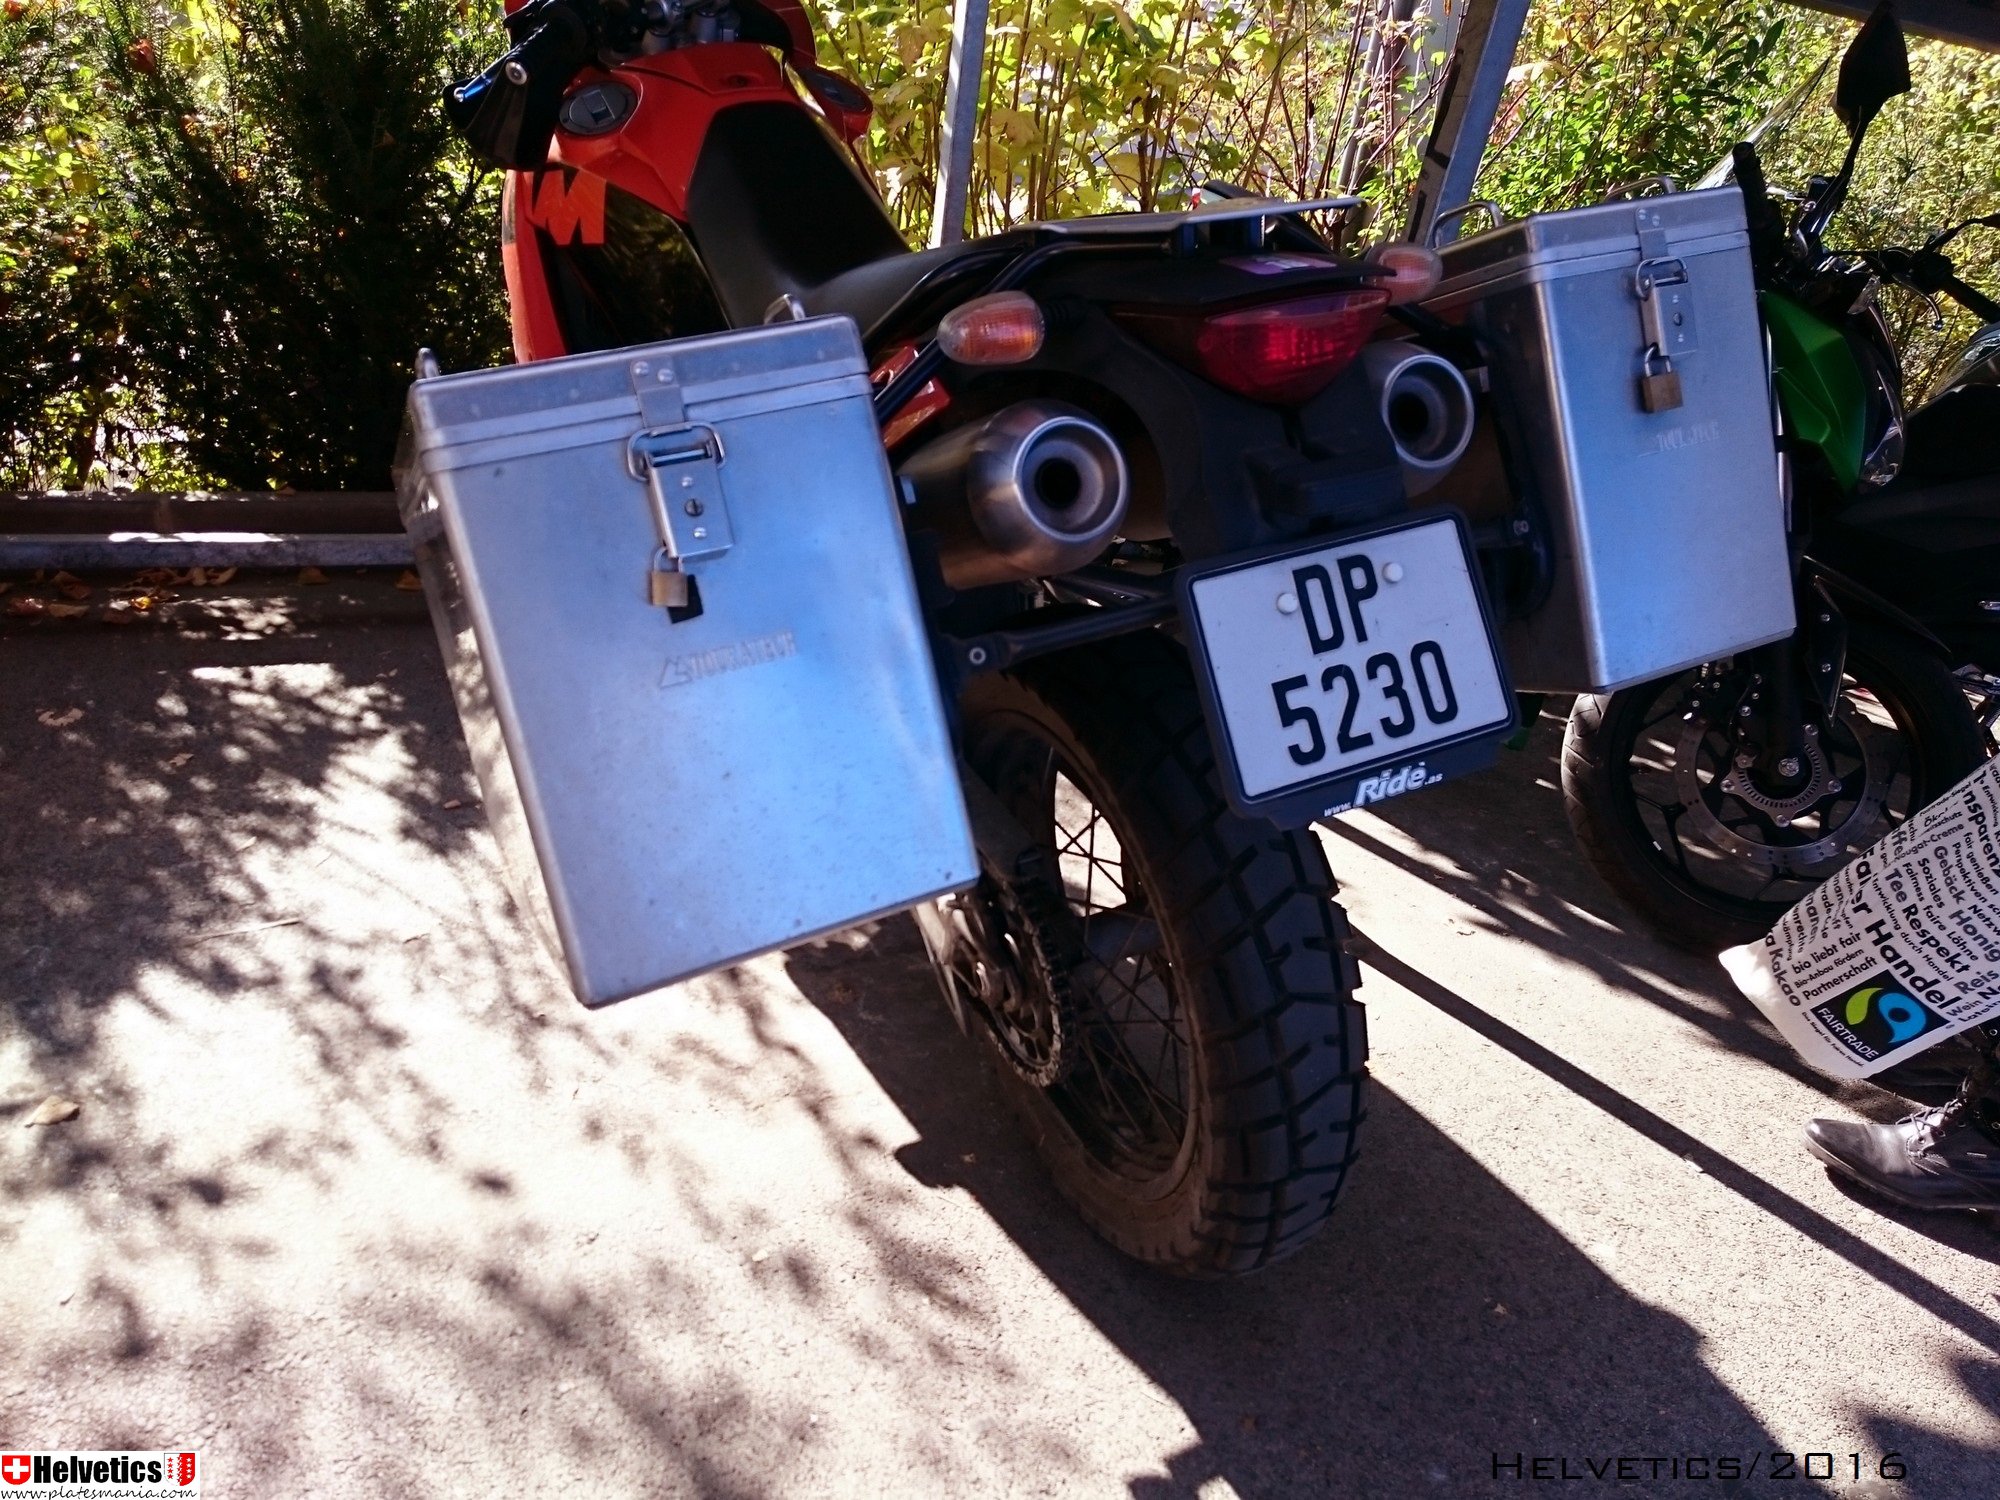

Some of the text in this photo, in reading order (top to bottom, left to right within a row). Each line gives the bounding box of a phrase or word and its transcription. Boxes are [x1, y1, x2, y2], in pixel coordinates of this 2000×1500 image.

[1292, 554, 1379, 656] DP
[1271, 640, 1459, 767] 5230
[1934, 846, 1965, 905] Gebäck
[1952, 842, 1988, 904] Perspektiven
[1964, 832, 2000, 896] fair genießen
[1885, 868, 1971, 973] Tee Respekt
[1902, 862, 1979, 962] Fairness faire Löhne
[1917, 858, 2000, 963] Soziales Honig
[1769, 948, 1802, 1007] Kakao
[1792, 932, 1862, 975] bio liebt fair
[1794, 949, 1865, 989] Bio-Anbau fördern
[1802, 956, 1878, 1001] Partnerschaft
[1865, 919, 1963, 1010] Handel
[1900, 931, 1923, 954] durch
[1922, 954, 1955, 982] Handel
[1953, 970, 2000, 995] Reis
[1818, 1008, 1879, 1059] FAIRTRADE
[1946, 999, 1983, 1017] Wein
